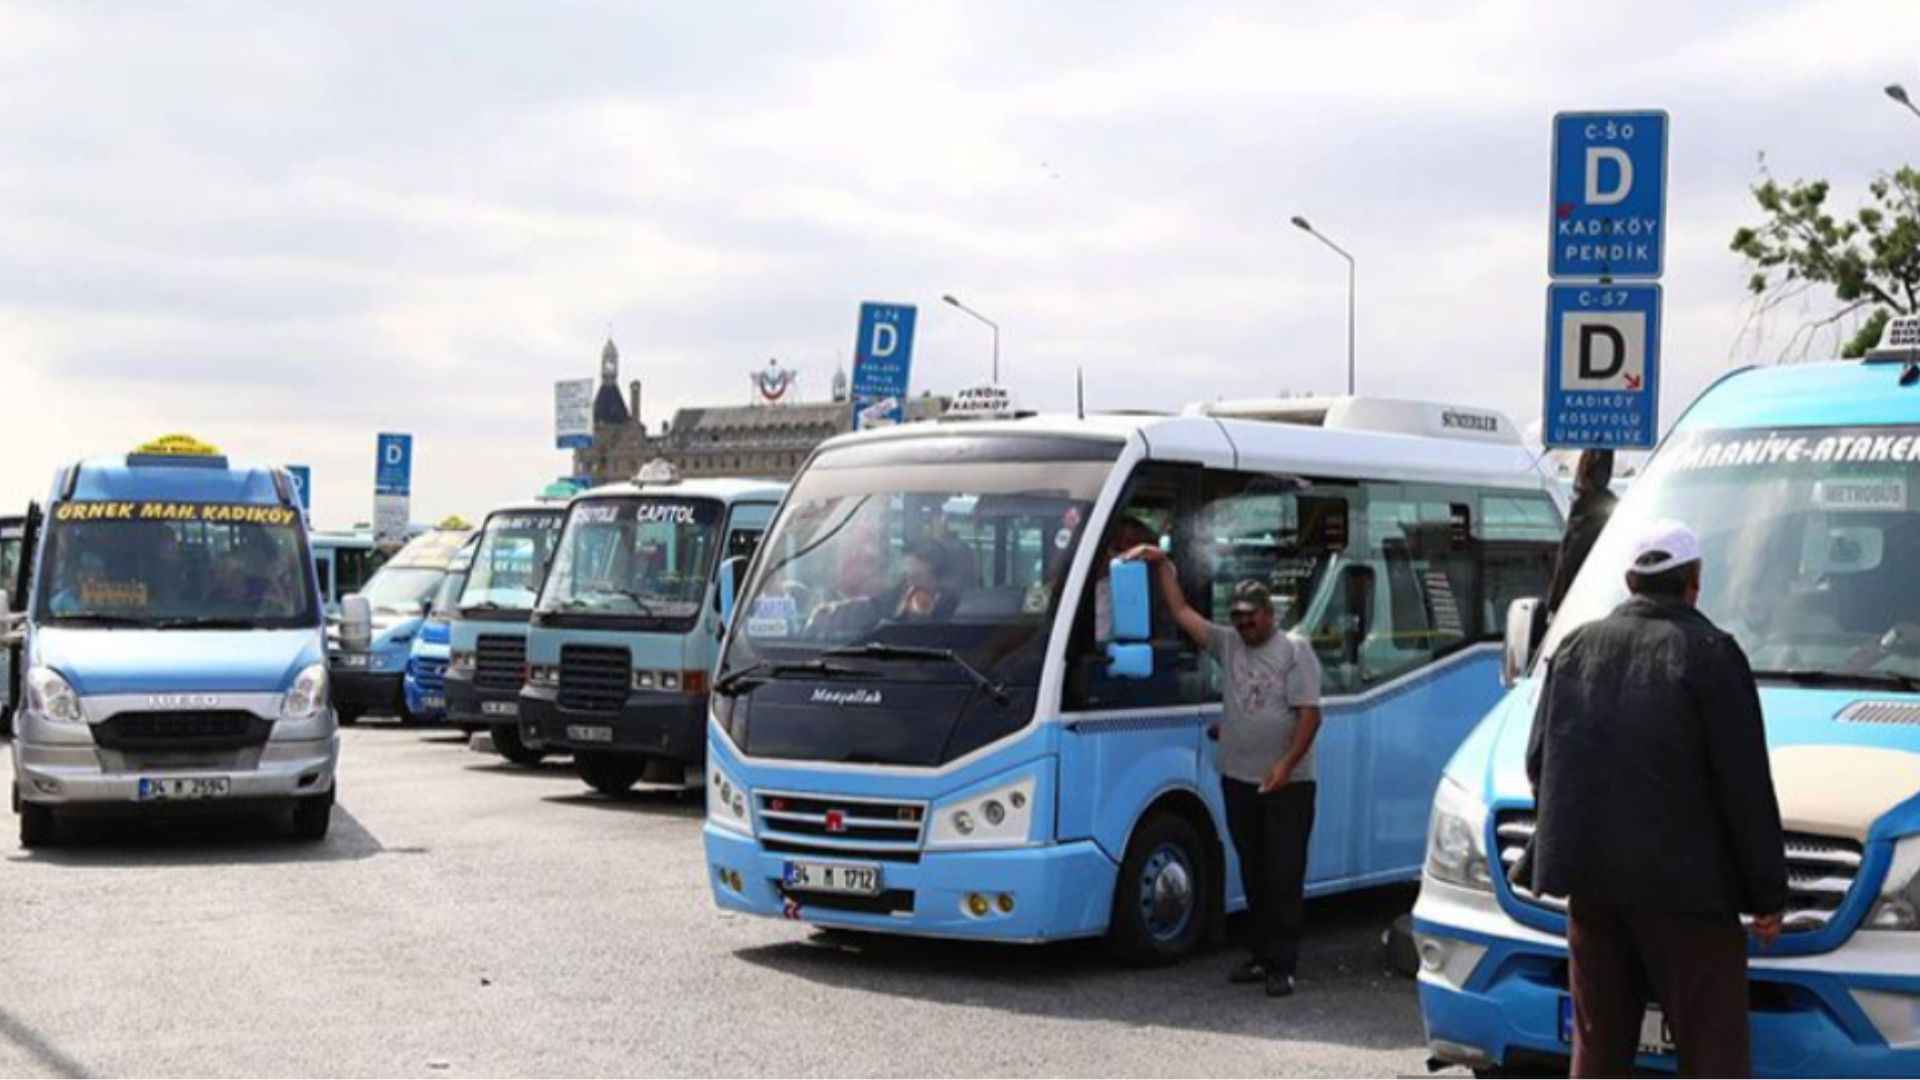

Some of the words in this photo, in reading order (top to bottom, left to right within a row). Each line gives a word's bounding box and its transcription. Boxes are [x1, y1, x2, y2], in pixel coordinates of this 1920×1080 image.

[1584, 121, 1635, 139] C-50
[1585, 146, 1634, 205] D
[1559, 218, 1656, 236] KADKÖY
[1565, 242, 1648, 260] PENDİK
[871, 322, 898, 357] D
[1578, 324, 1626, 379] D
[385, 444, 403, 464] D
[57, 502, 135, 520] ÖRNEK
[140, 503, 197, 520] MAH.
[636, 505, 696, 523] CAPITOL
[845, 869, 873, 889] 1712
